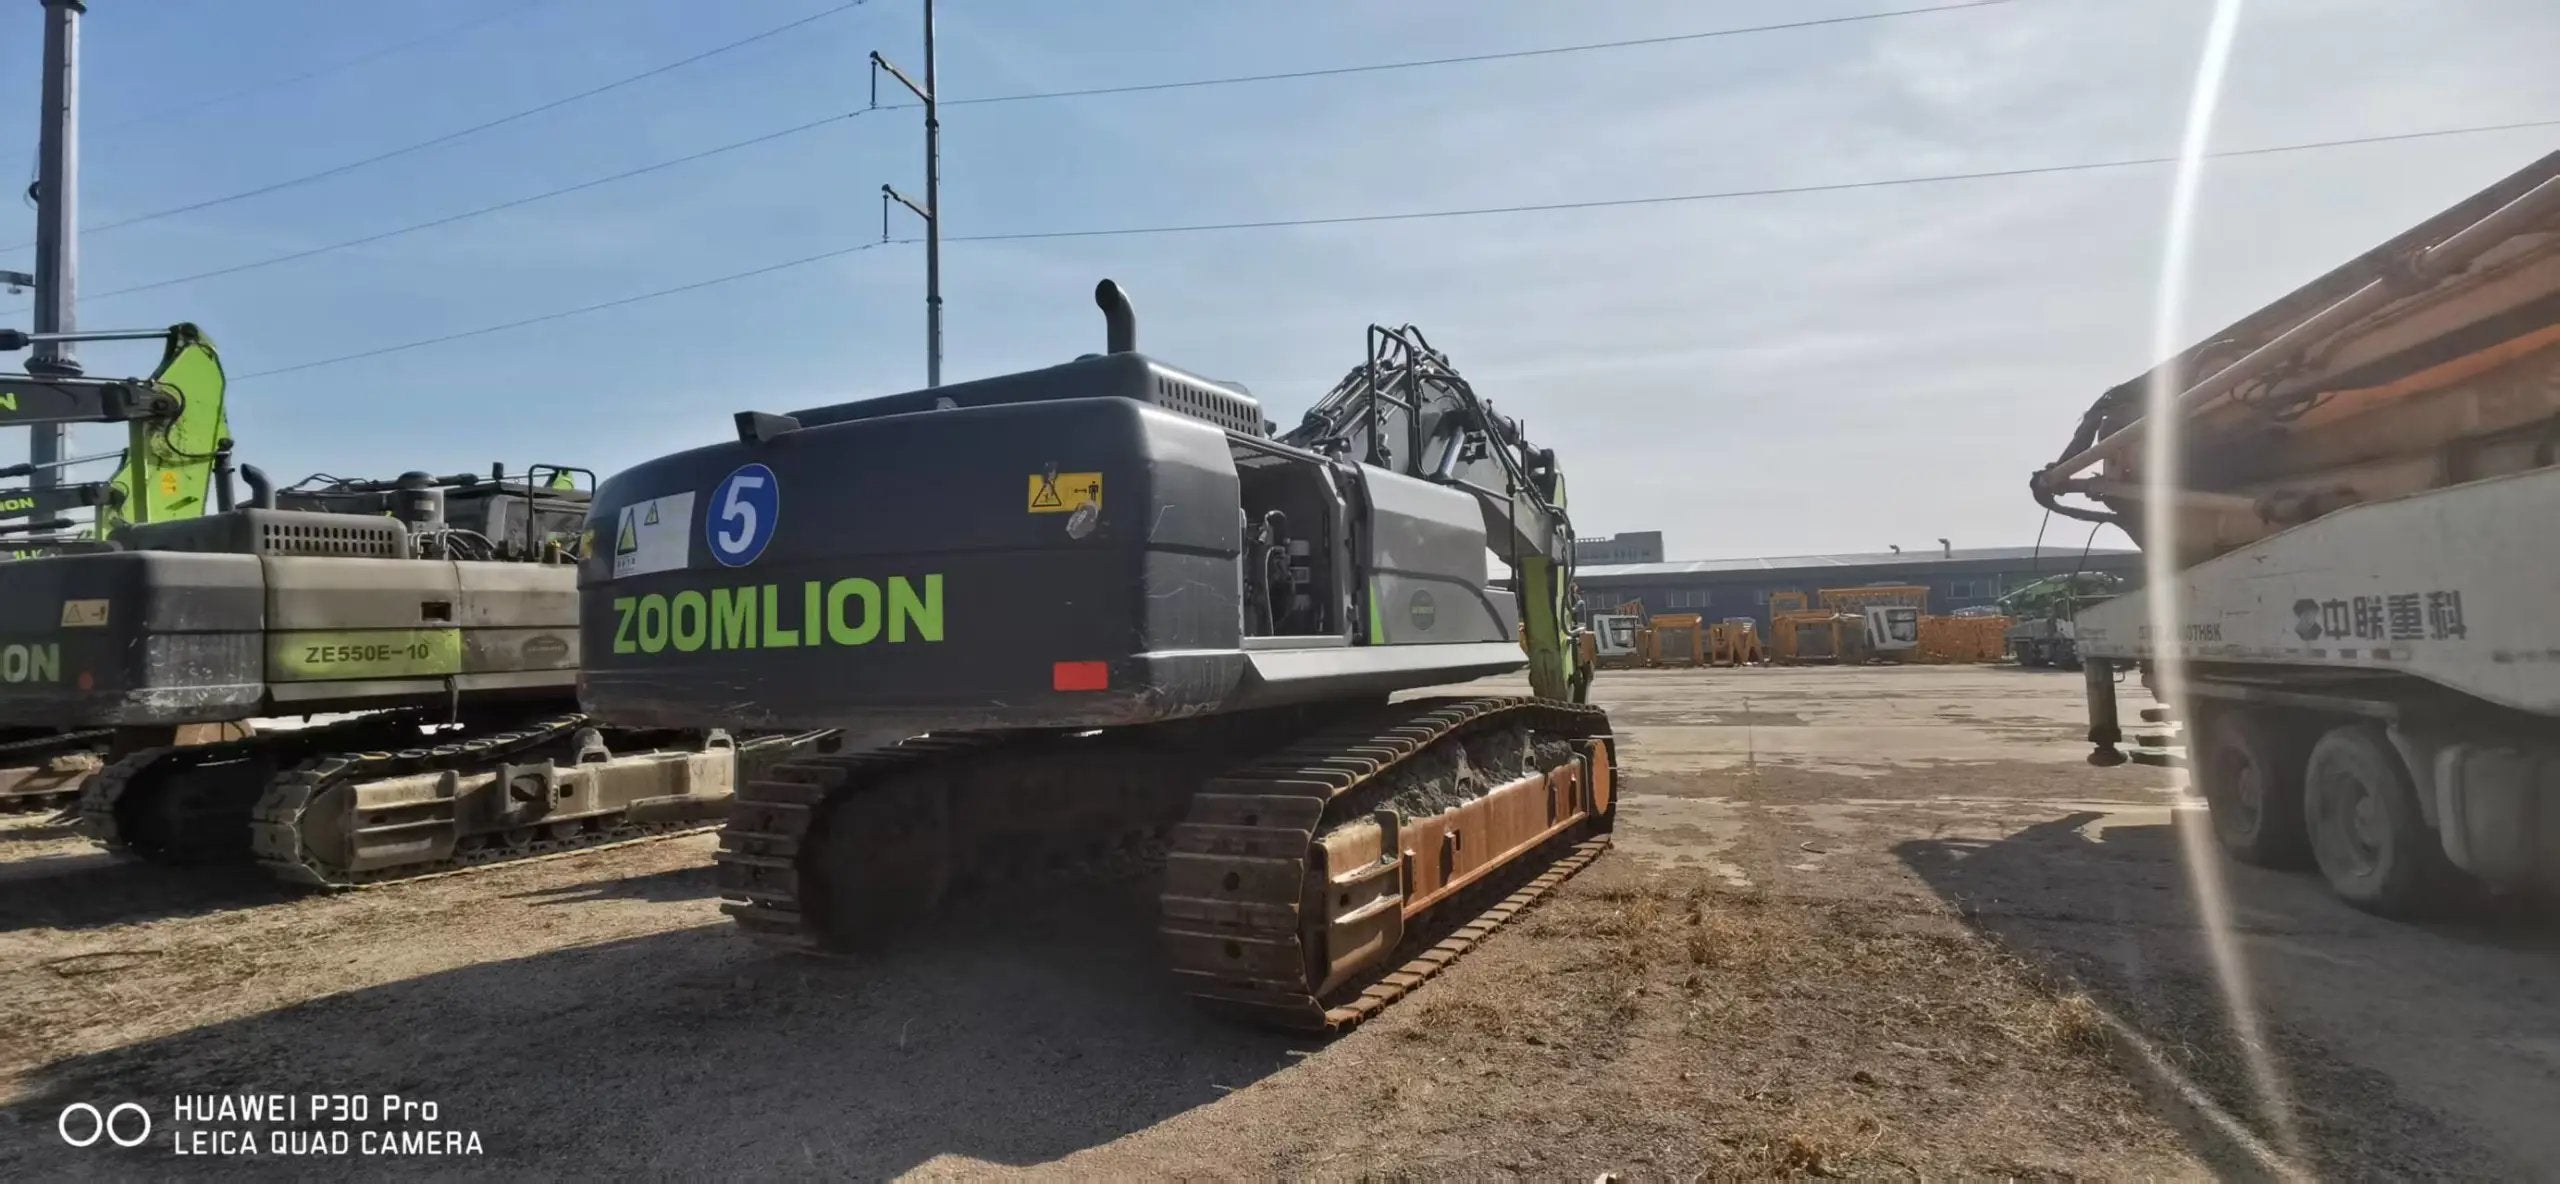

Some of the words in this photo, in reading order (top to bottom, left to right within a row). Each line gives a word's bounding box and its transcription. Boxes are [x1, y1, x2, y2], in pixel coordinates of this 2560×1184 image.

[718, 475, 764, 554] 5
[613, 573, 943, 654] ZOOMLION
[2322, 590, 2467, 641] 中联重科
[0, 643, 60, 683] ON
[304, 643, 430, 664] ZE550E-10
